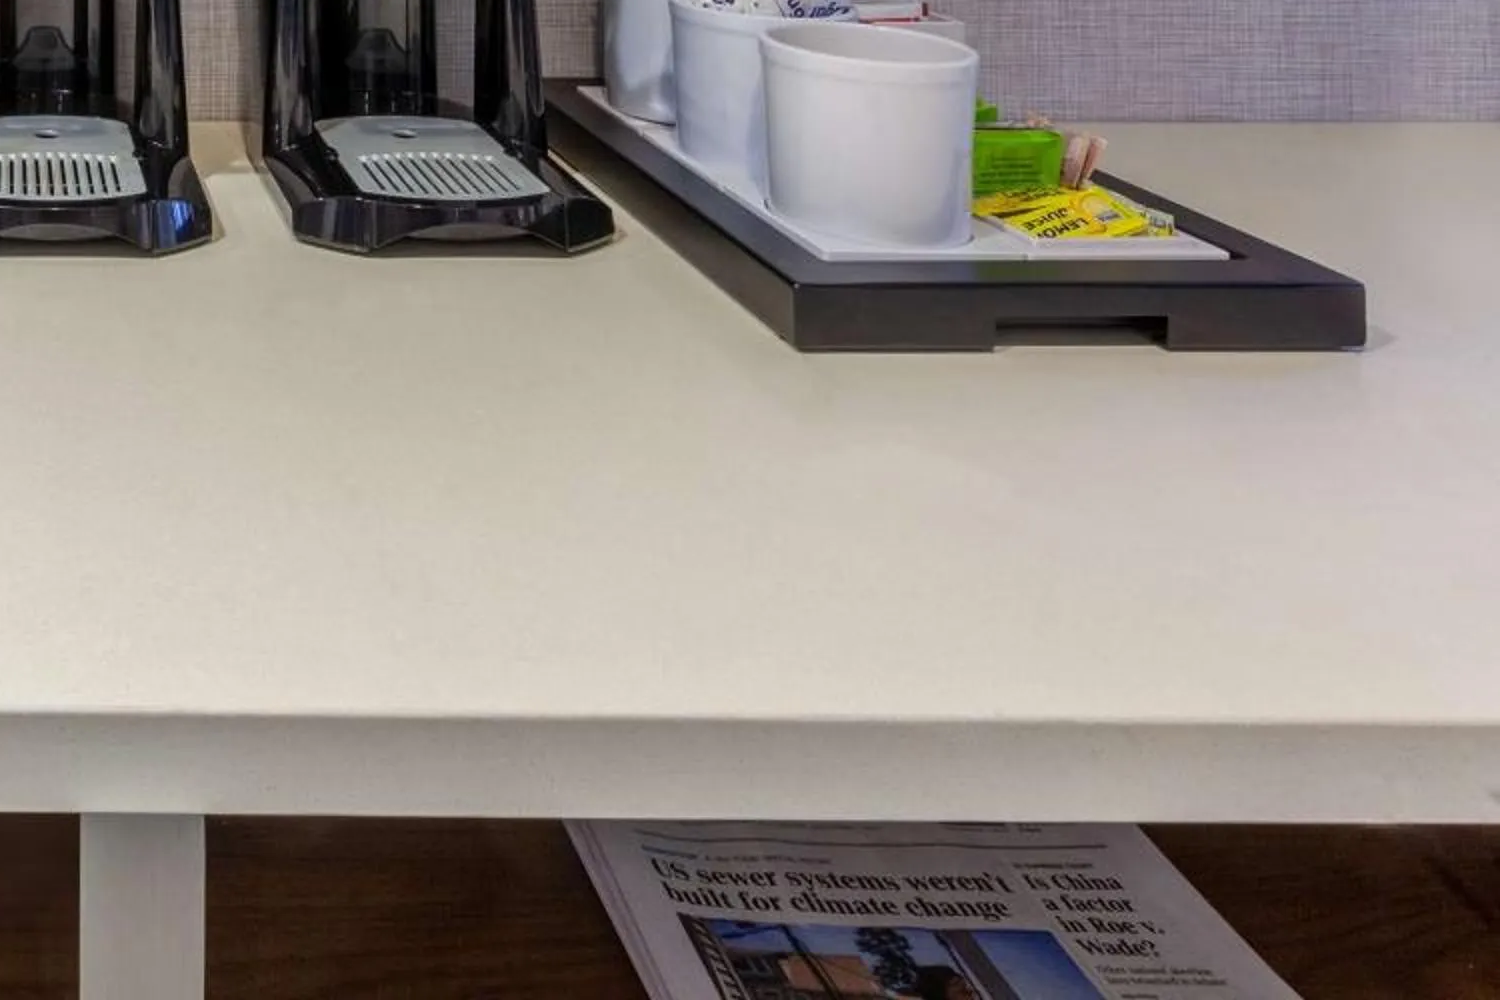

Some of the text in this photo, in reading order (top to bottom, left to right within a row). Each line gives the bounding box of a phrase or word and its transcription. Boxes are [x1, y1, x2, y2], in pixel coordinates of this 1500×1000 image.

[651, 858, 690, 881] US
[695, 868, 777, 887] sewer
[784, 870, 901, 892] systems
[903, 872, 1014, 894] weren't
[1021, 873, 1124, 891] Is China
[661, 881, 1013, 921] built for climate change
[1041, 895, 1134, 913] a factor
[1055, 915, 1166, 935] in Roe v.
[1076, 938, 1161, 957] Wade?
